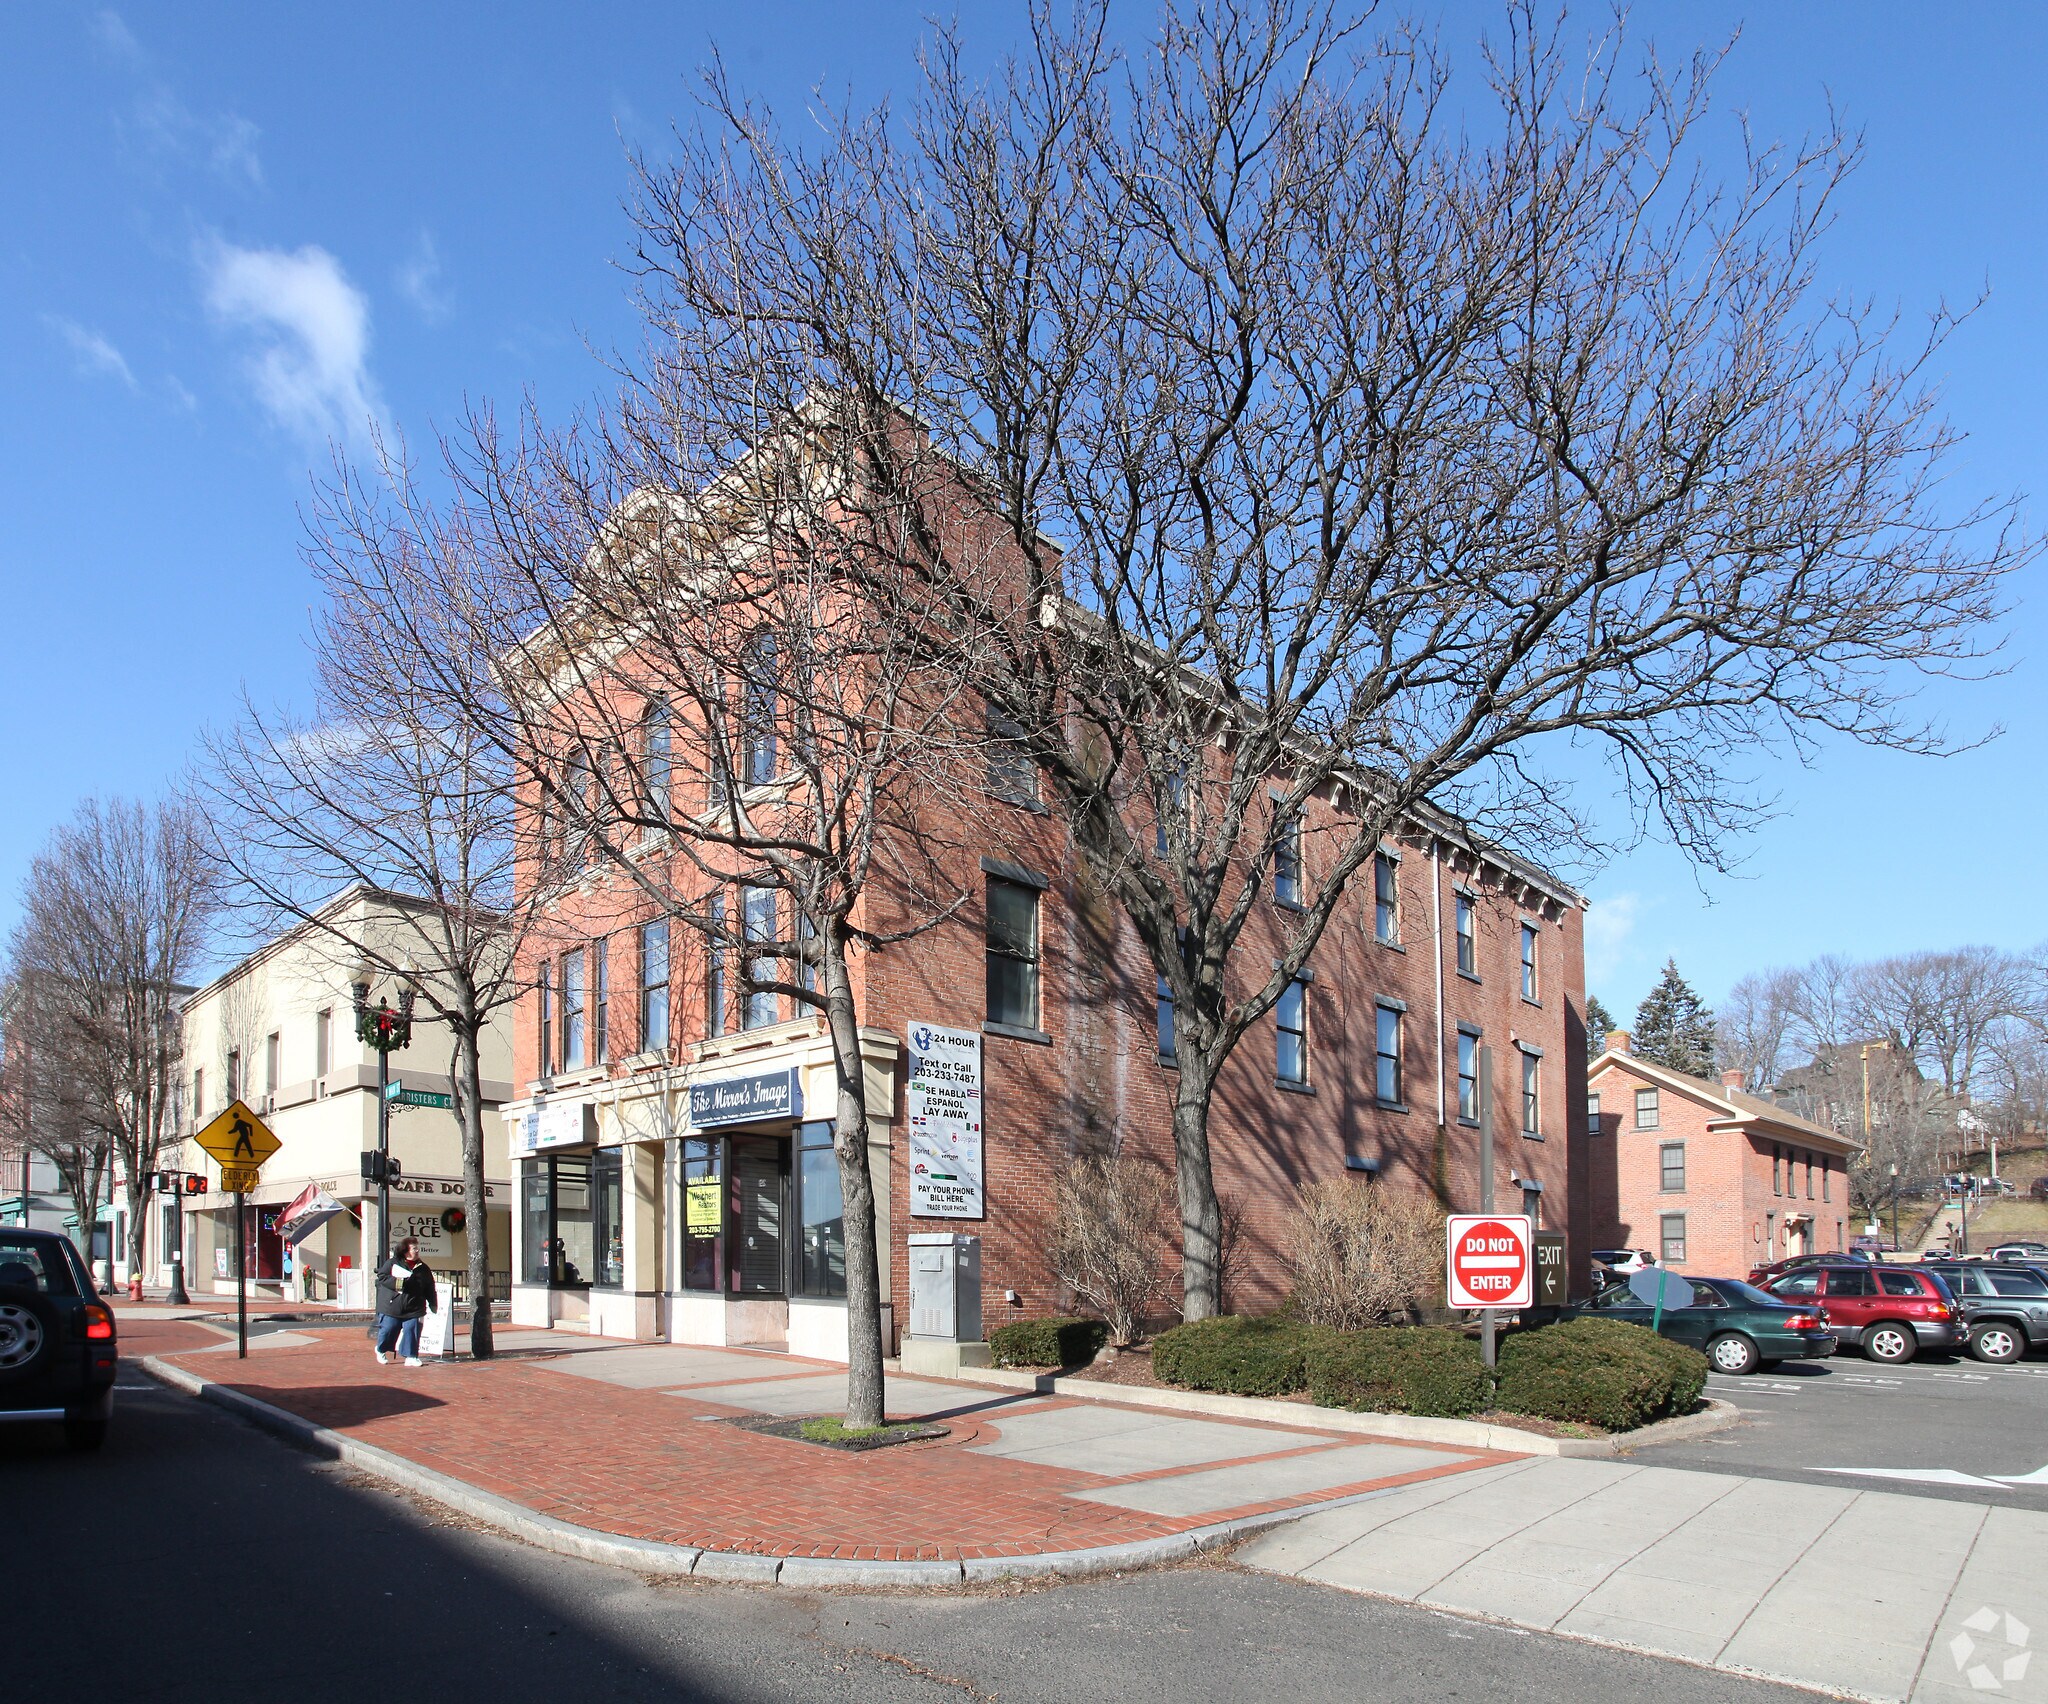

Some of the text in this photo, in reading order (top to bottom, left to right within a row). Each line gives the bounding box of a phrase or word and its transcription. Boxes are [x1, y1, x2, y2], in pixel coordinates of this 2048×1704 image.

[934, 1034, 975, 1048] 24 HOUR
[919, 1056, 971, 1073] Text or Call
[914, 1067, 975, 1083] 203-233-7487
[693, 1080, 788, 1113] The Mirror's Image
[926, 1086, 966, 1099] SE HABLA
[926, 1097, 965, 1109] ESPAÑOL
[923, 1107, 969, 1120] LAY AWAY
[914, 1146, 931, 1156] Sprint
[223, 1170, 257, 1181] ELDERLY
[688, 1175, 720, 1185] AVAILABLE
[200, 1180, 207, 1191] 2
[232, 1181, 250, 1191] XING
[918, 1184, 975, 1196] PAY YOUR PHONE
[691, 1191, 717, 1201] Weichert
[930, 1194, 964, 1203] BILL HERE
[697, 1200, 717, 1209] Realtors
[941, 1204, 953, 1212] YOUR
[408, 1216, 439, 1226] CAFE
[1466, 1238, 1515, 1253] DO NOT
[1537, 1246, 1562, 1265] EXIT
[1470, 1275, 1512, 1290] ENTER
